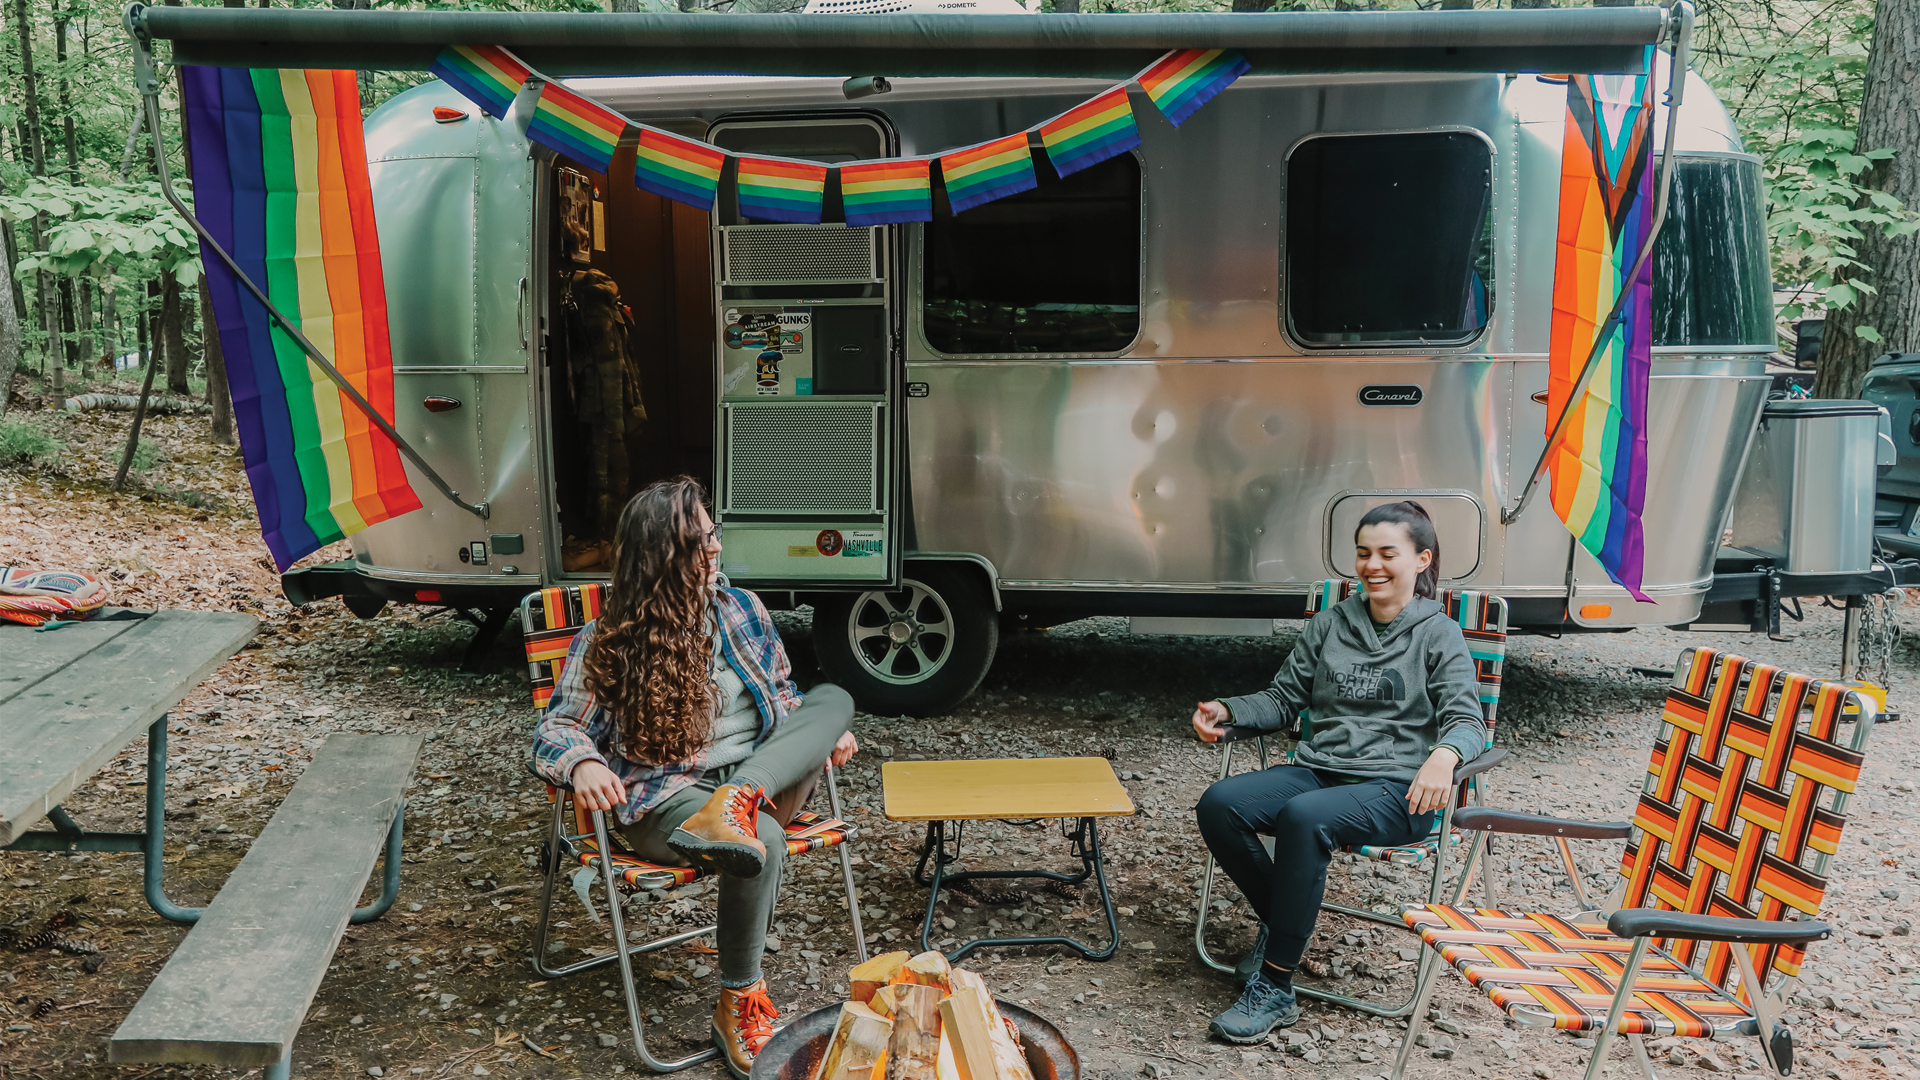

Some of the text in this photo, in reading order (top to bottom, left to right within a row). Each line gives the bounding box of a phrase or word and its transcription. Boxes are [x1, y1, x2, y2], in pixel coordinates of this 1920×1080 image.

[744, 321, 776, 329] AIRSTREAM
[777, 316, 809, 324] GUNKS
[1364, 390, 1417, 400] Caravel
[843, 540, 882, 551] NASHVILLE
[1351, 663, 1382, 678] THE
[1326, 670, 1378, 688] NORTH
[1337, 685, 1376, 700] FACE
